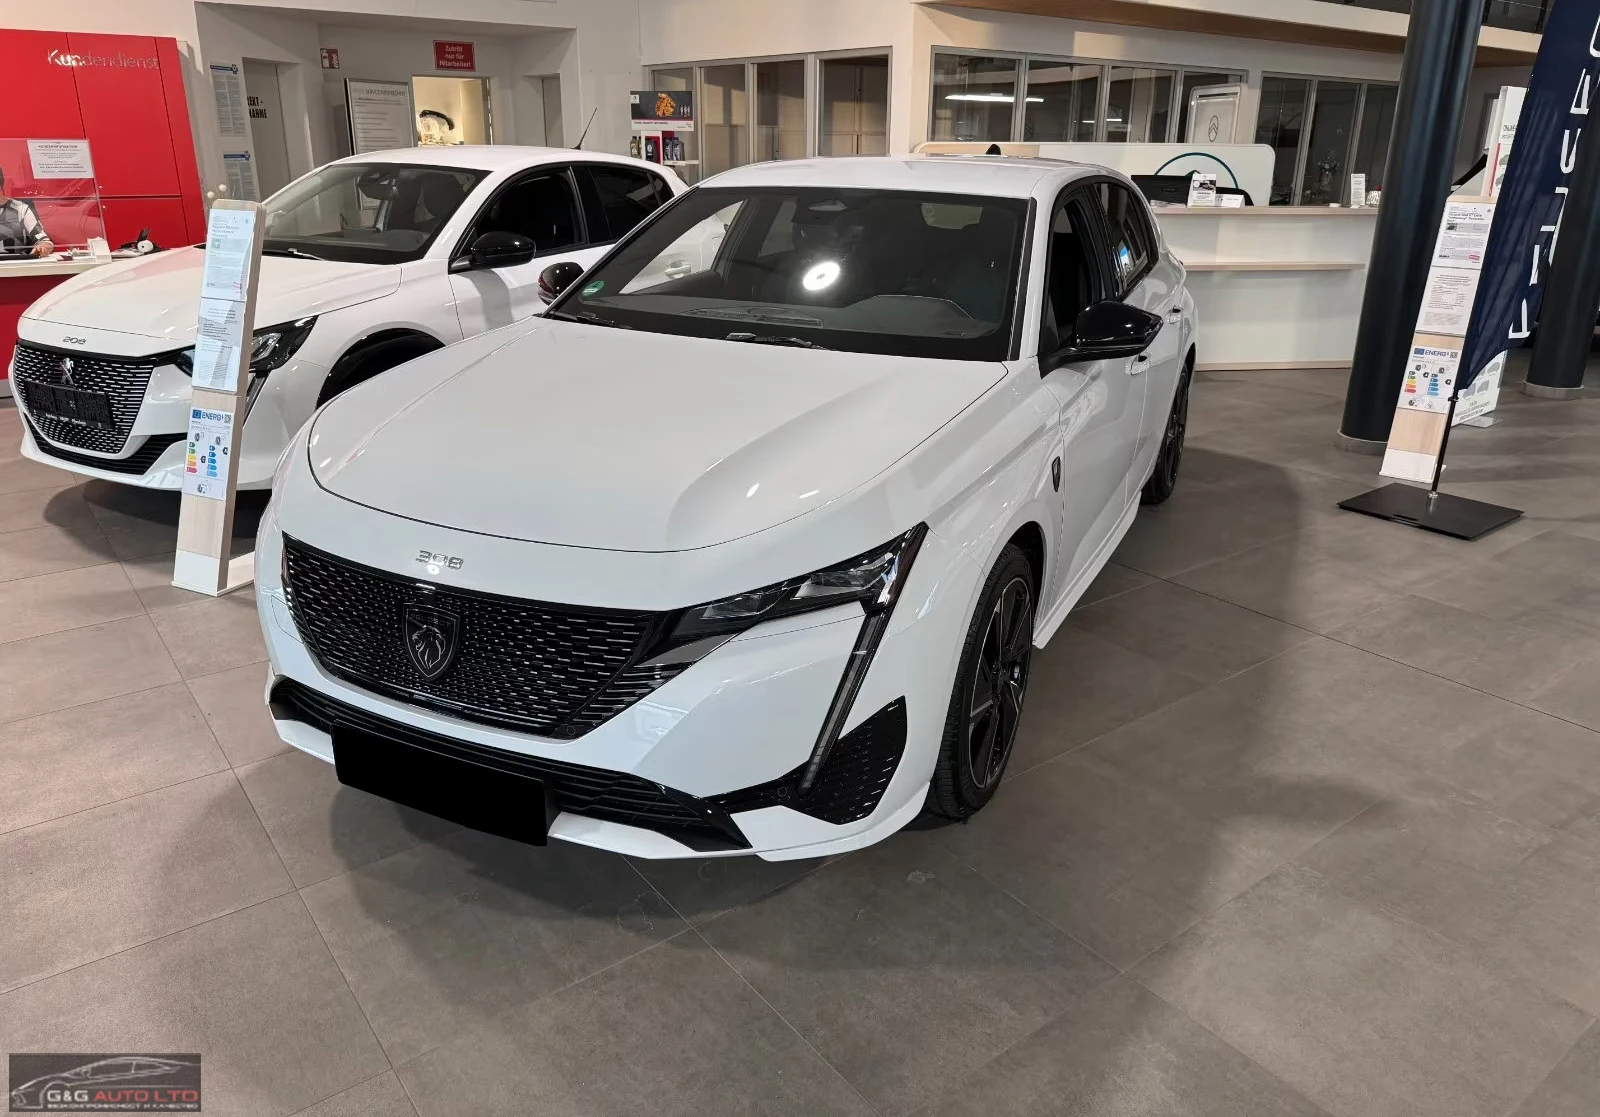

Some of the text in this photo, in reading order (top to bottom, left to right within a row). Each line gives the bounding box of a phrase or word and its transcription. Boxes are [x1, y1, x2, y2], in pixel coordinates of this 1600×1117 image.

[47, 49, 159, 68] Kundendienst
[62, 336, 87, 345] 208
[415, 550, 464, 570] 308
